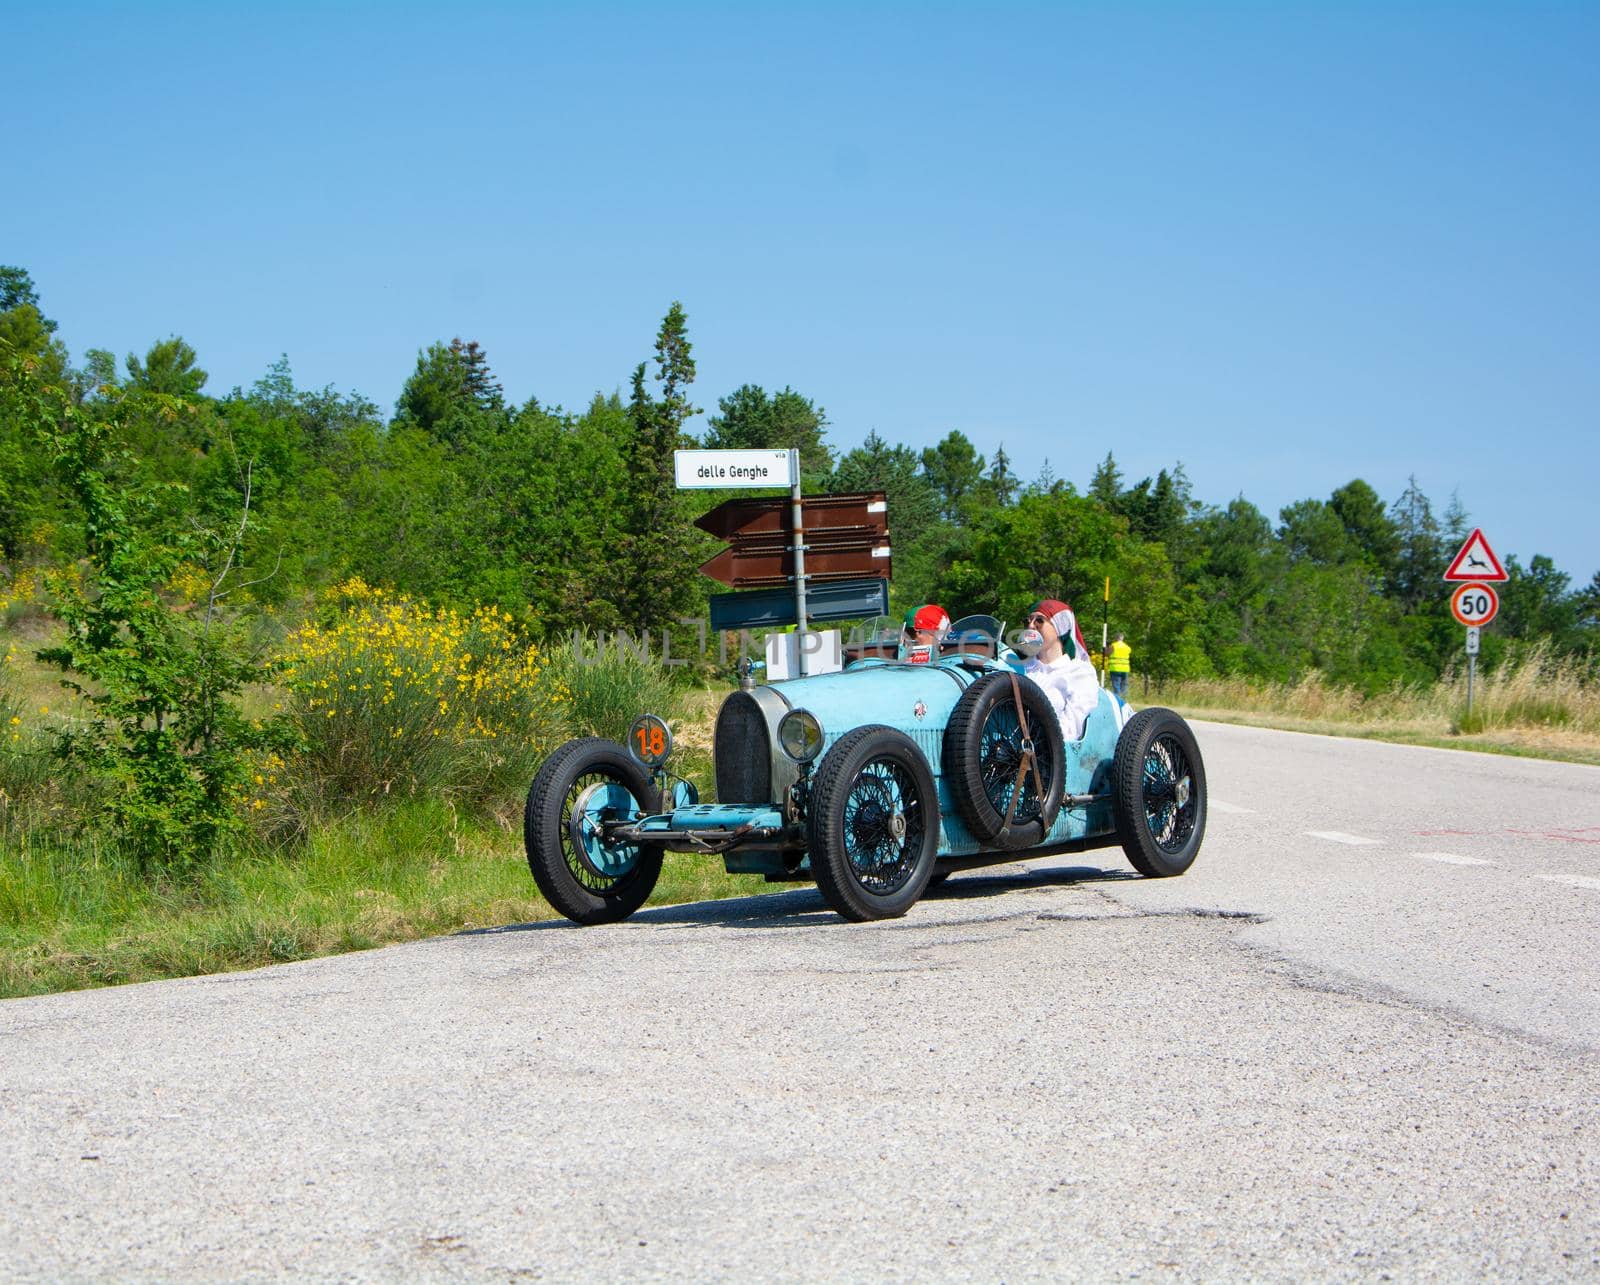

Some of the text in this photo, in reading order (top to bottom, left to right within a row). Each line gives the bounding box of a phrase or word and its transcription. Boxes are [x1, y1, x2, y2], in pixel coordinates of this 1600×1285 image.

[697, 465, 768, 480] delle Genghe
[1462, 595, 1488, 615] 50
[636, 726, 665, 756] 18
